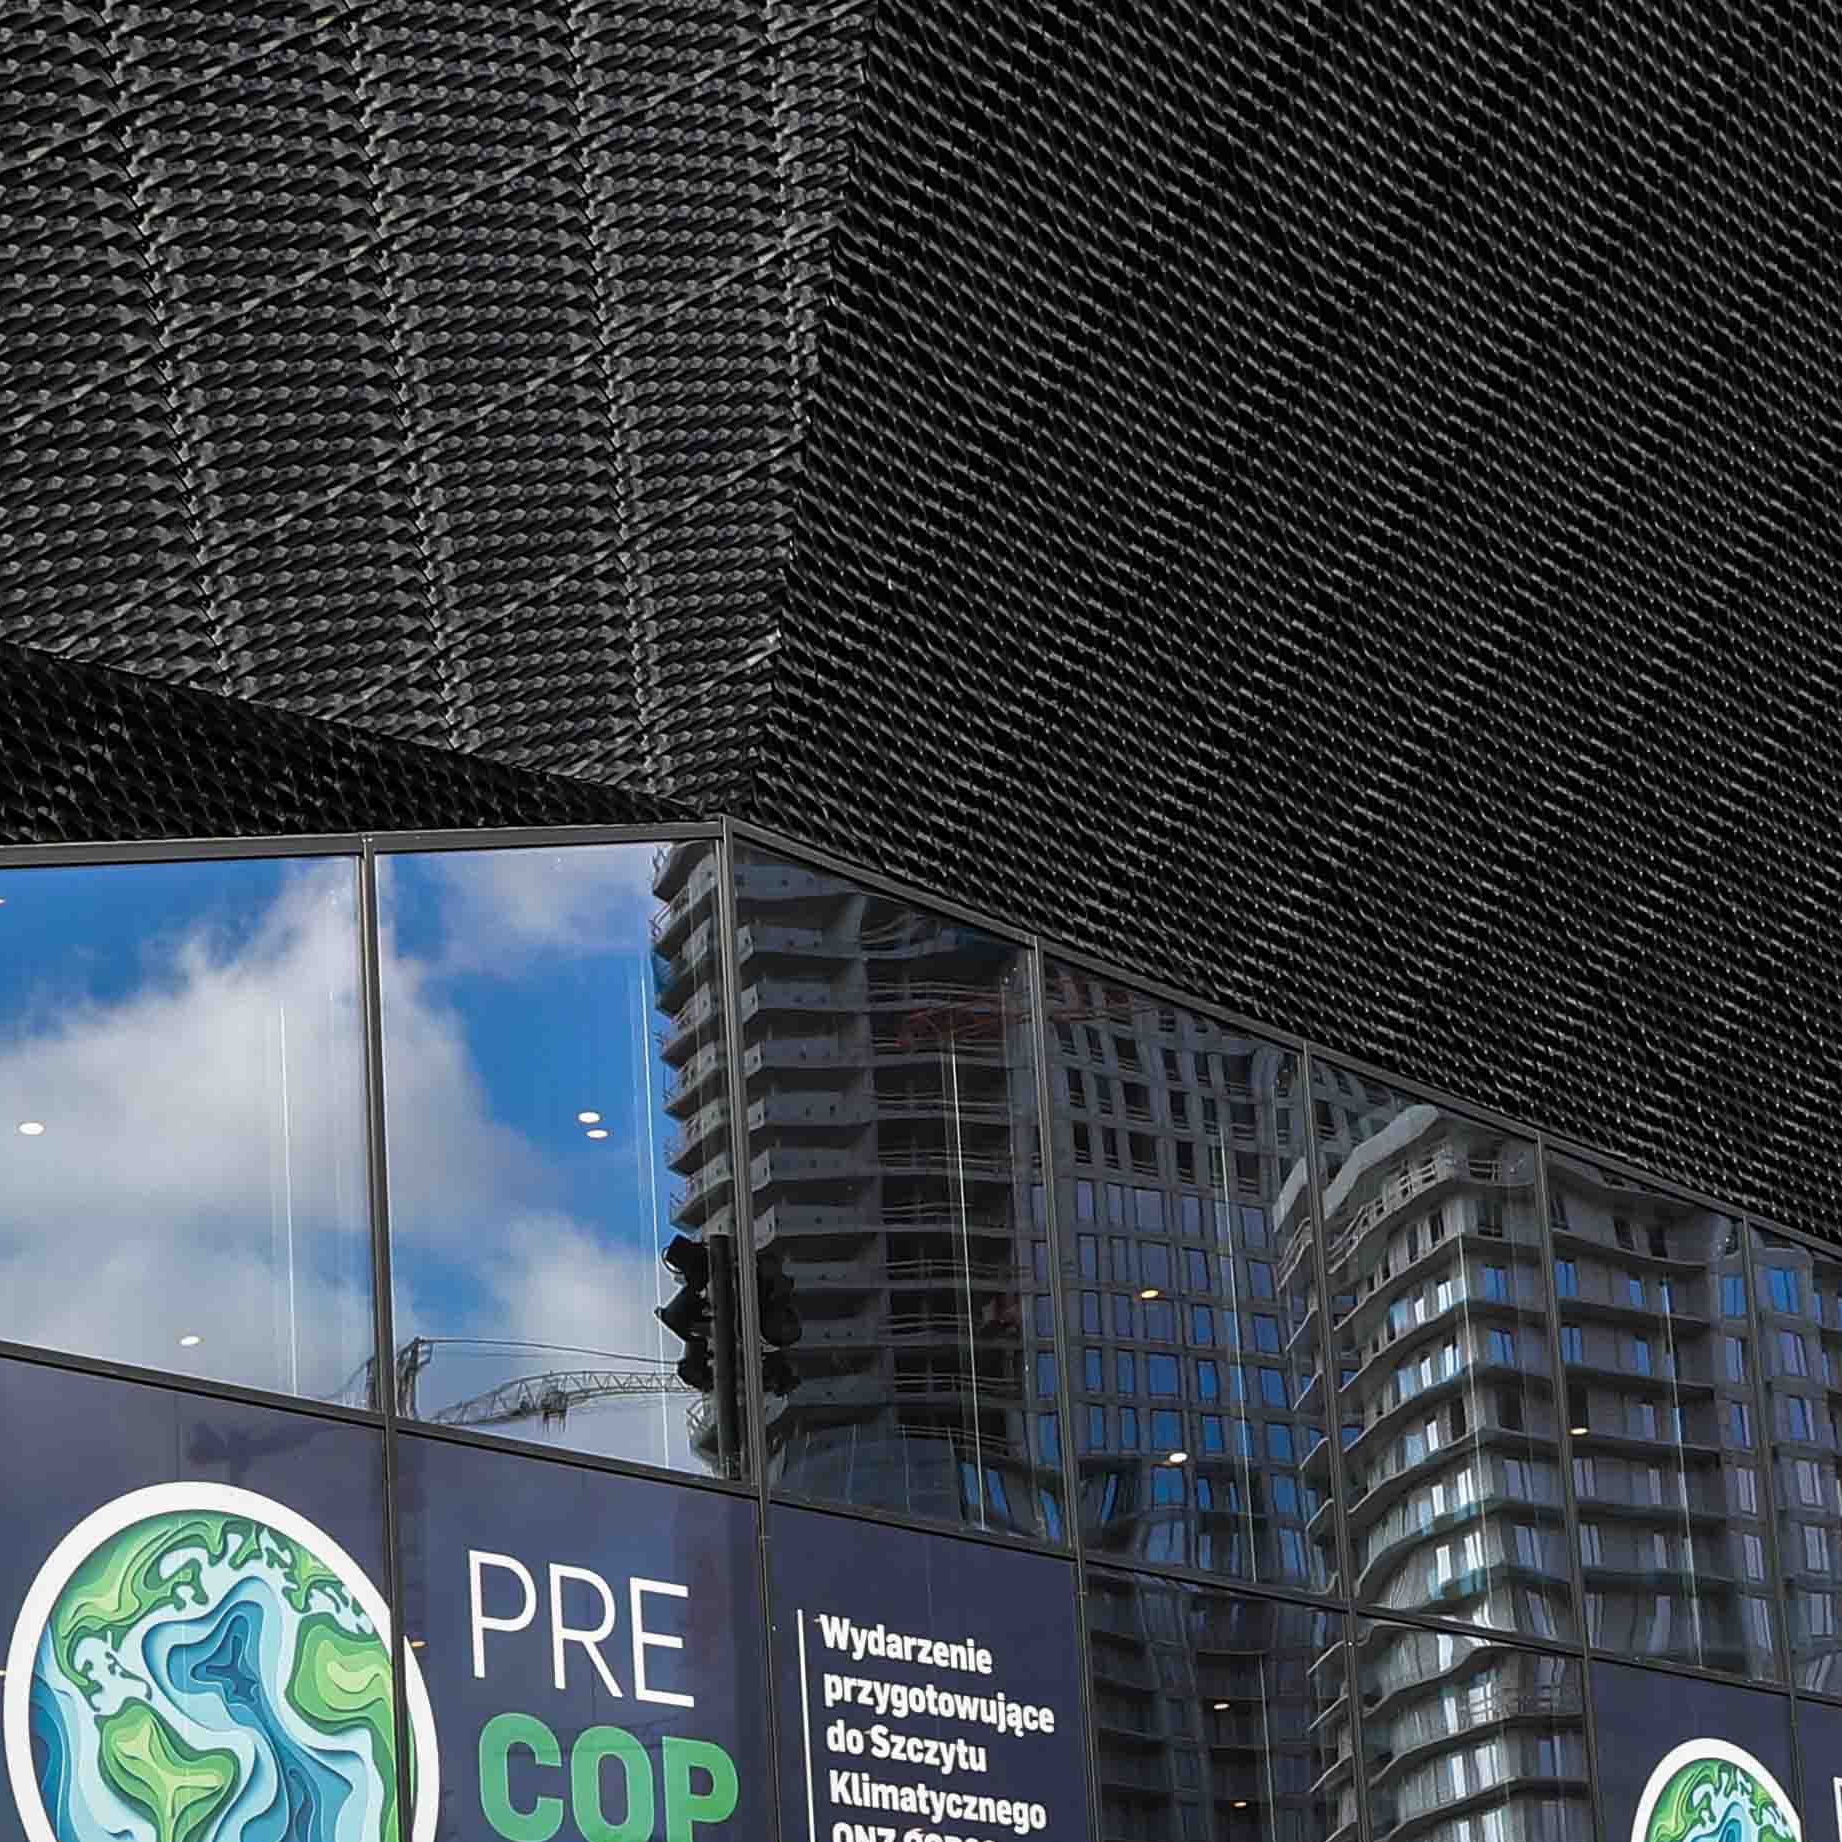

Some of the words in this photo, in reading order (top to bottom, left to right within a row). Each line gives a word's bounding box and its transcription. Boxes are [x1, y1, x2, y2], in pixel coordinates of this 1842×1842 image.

[468, 1550, 696, 1709] PRE
[819, 1613, 993, 1675] Wydarzenie
[824, 1672, 1055, 1738] przygotowujące
[826, 1719, 864, 1755] do
[869, 1724, 987, 1775] Szczytu
[829, 1769, 1047, 1835] Klimatycznego
